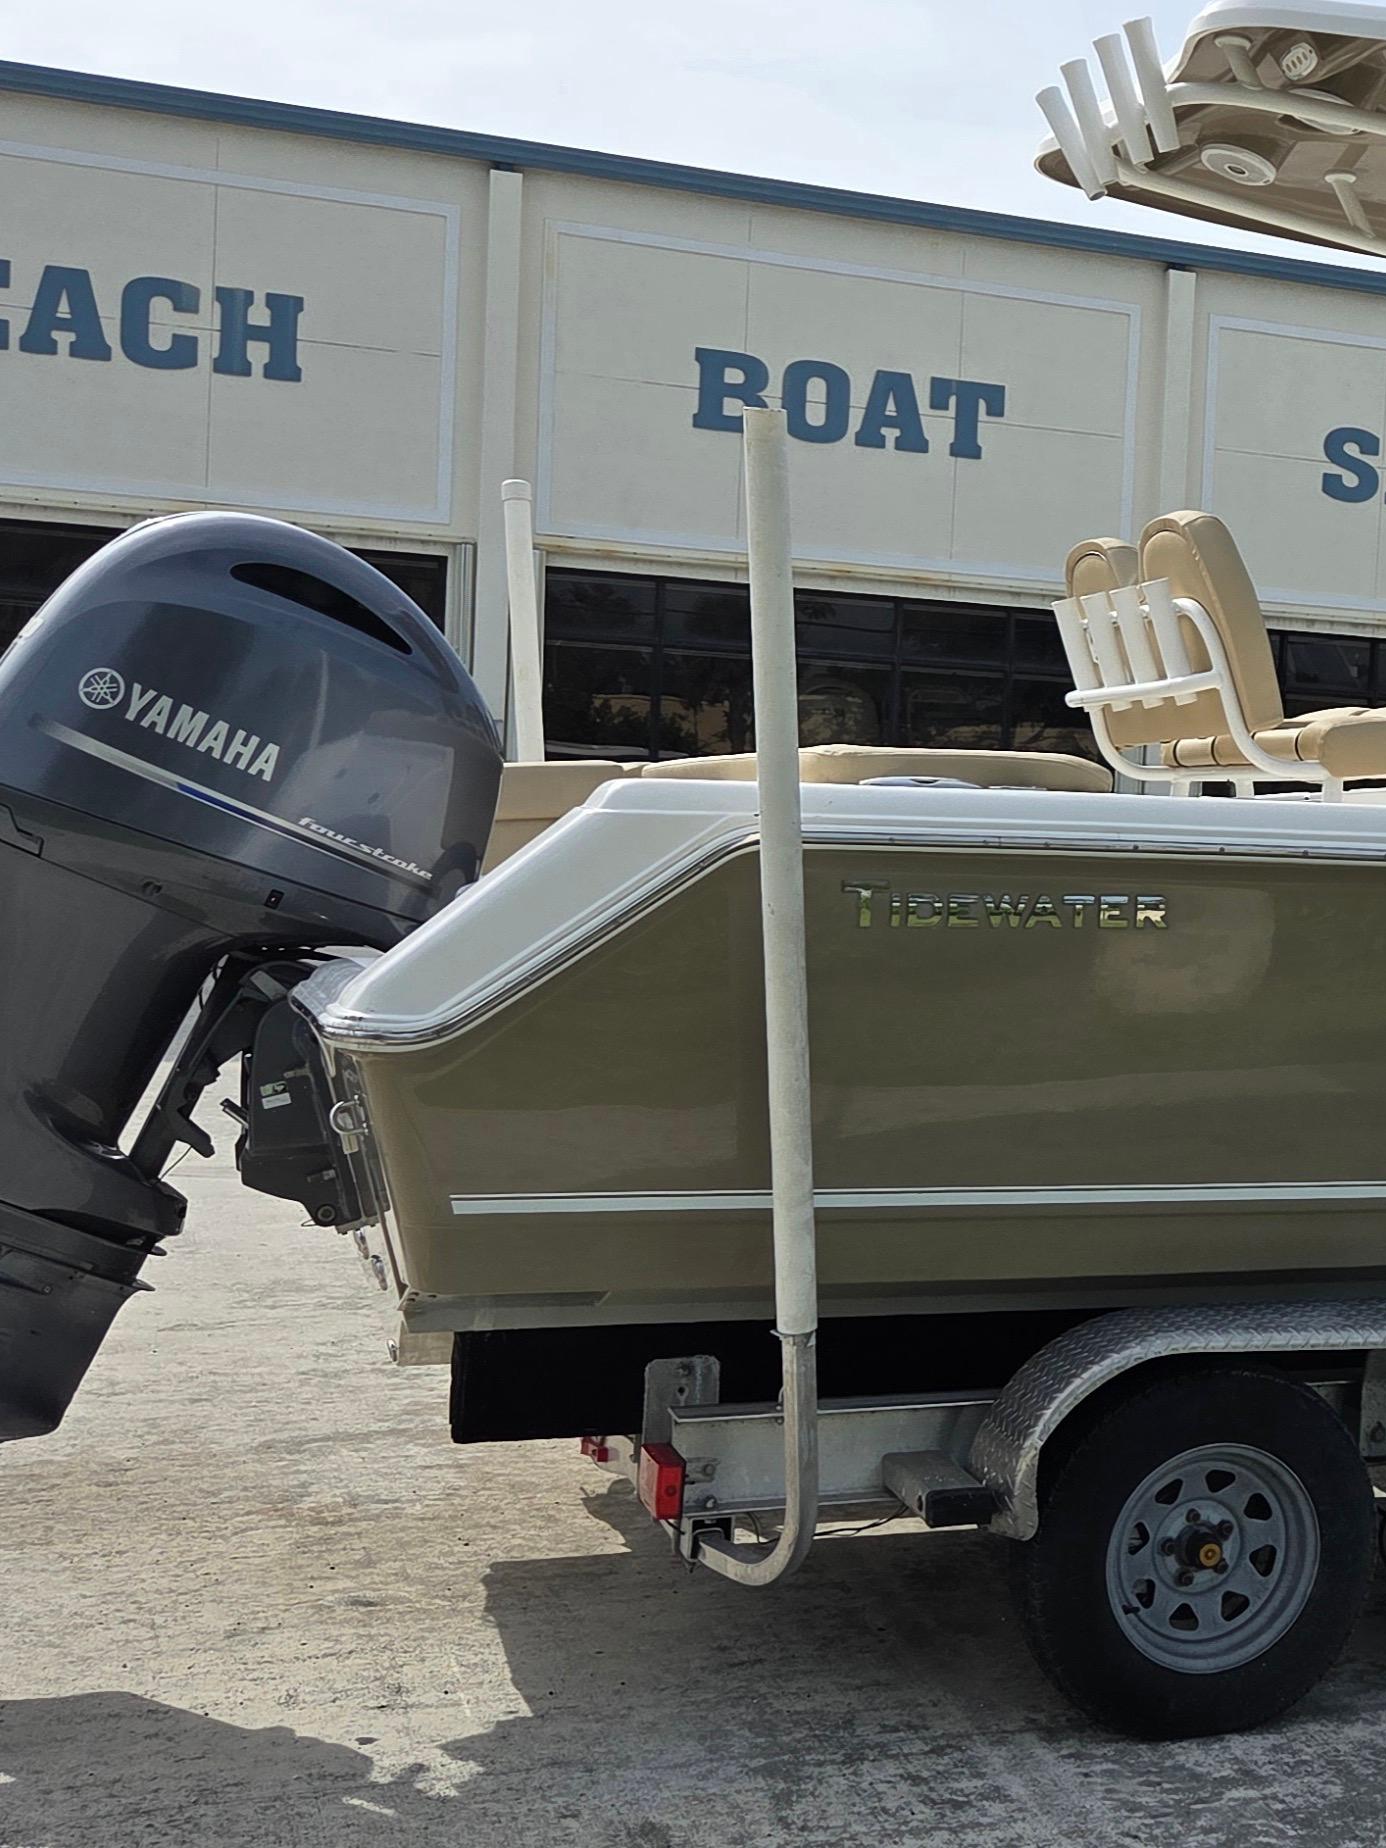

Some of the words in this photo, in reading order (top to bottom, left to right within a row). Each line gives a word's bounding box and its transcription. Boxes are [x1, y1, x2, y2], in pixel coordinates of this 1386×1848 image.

[0, 258, 304, 383] ACH
[692, 346, 1006, 460] BOAT
[124, 682, 281, 782] YAMAHA
[841, 879, 1169, 930] TIDEWATER
